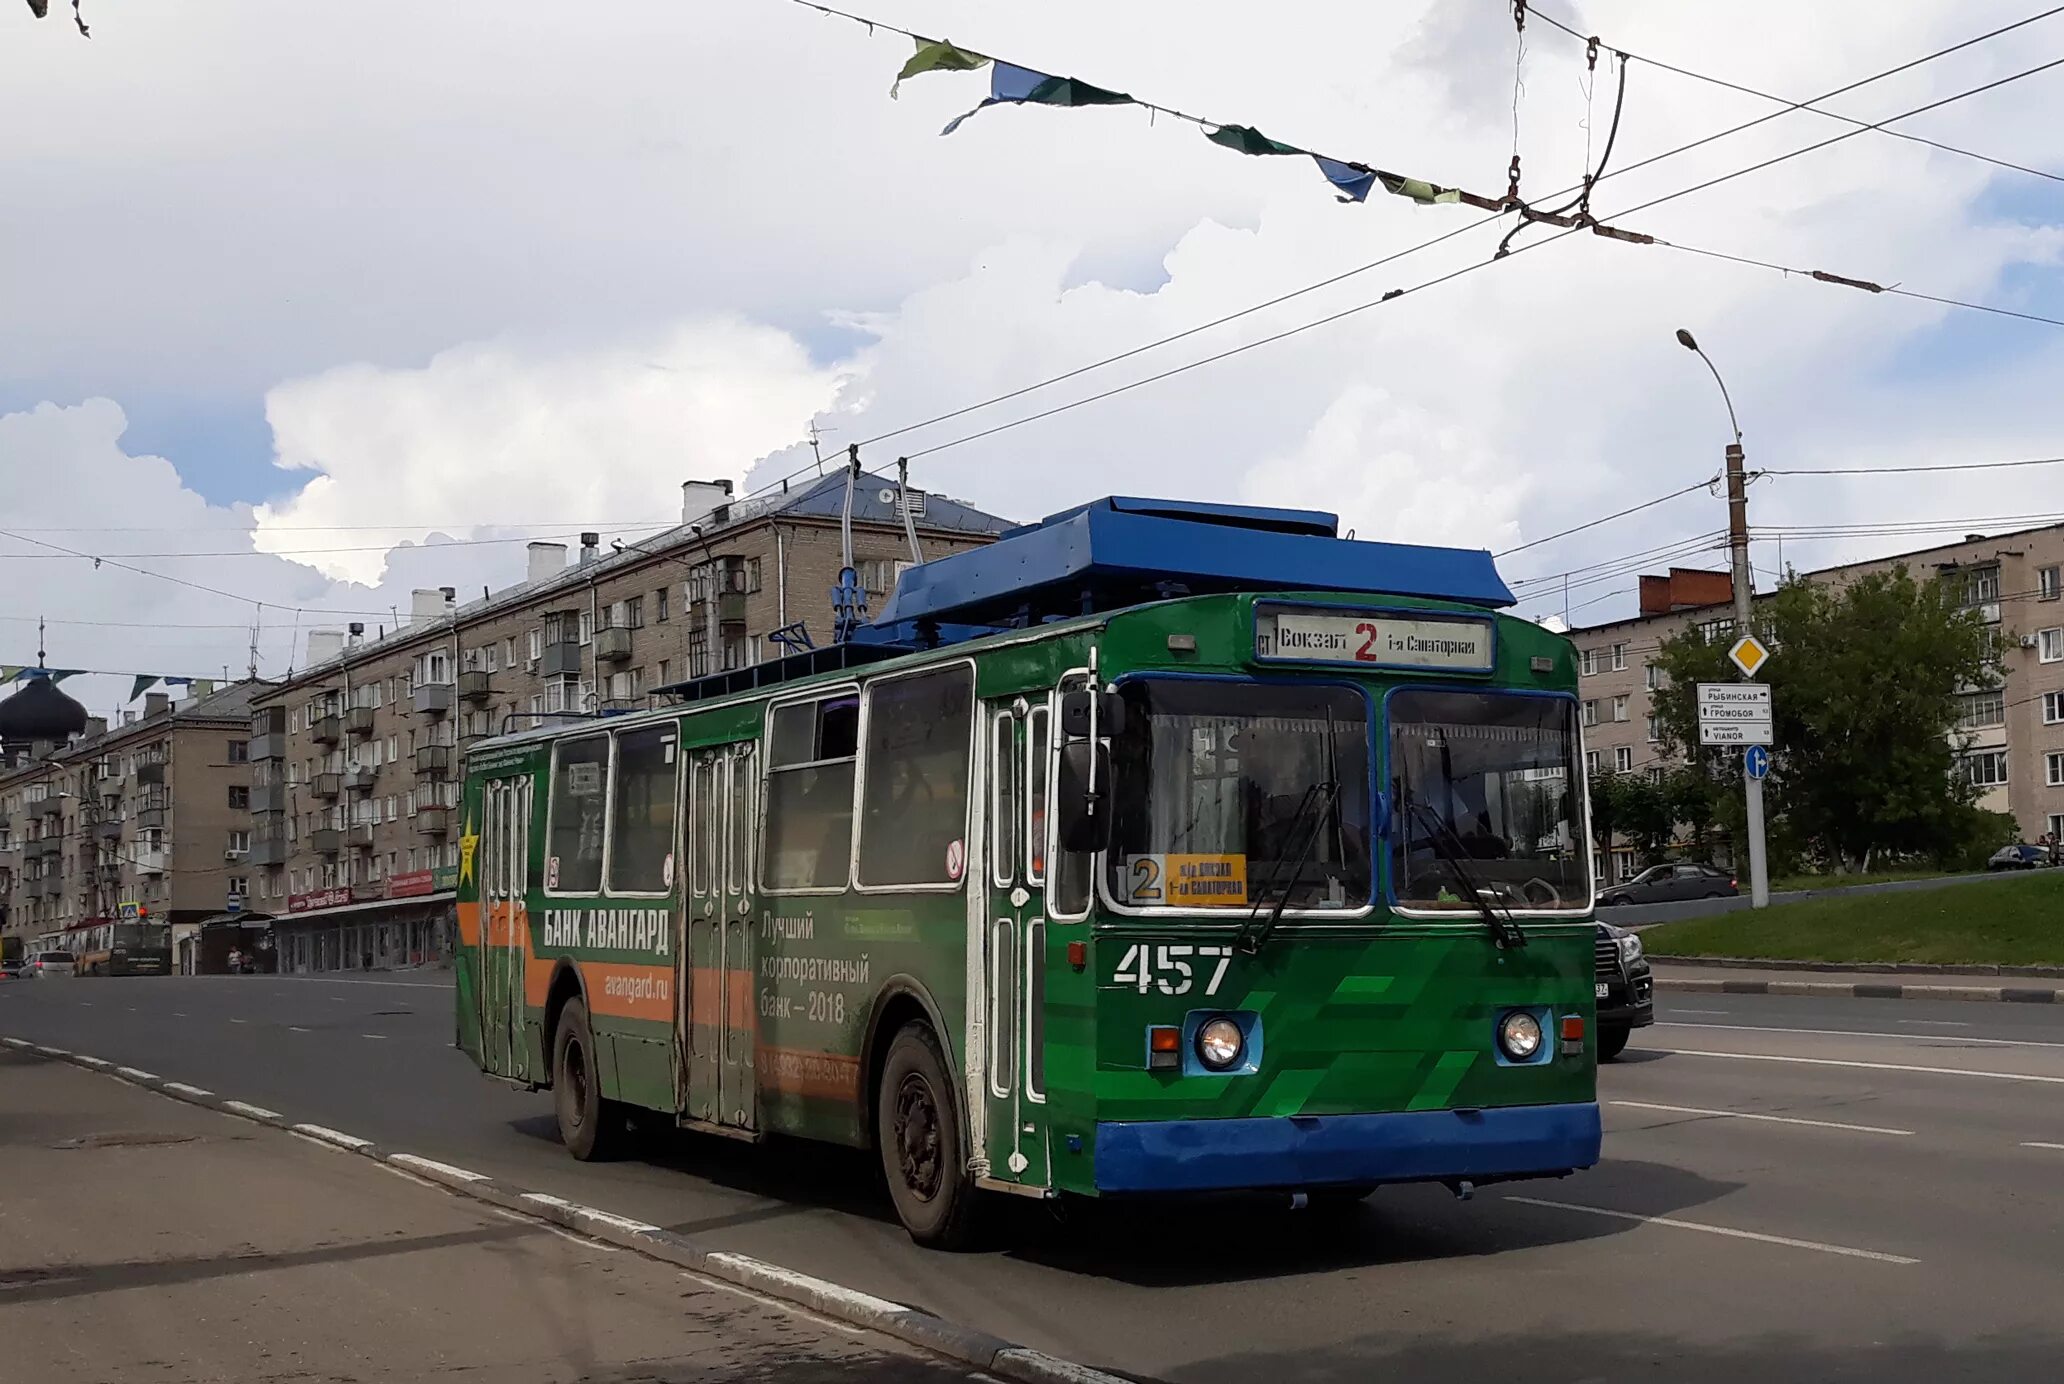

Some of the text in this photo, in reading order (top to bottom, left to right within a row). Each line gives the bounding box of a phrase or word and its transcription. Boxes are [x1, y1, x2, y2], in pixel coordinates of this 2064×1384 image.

[1280, 628, 1347, 649] Вокзал
[1355, 623, 1378, 661] 2
[1407, 635, 1475, 657] Санаторная
[1708, 693, 1758, 701] РЫБИНСКАЯ
[1710, 709, 1754, 717] ГРОМОБОЯ
[1713, 732, 1744, 740] VIANOR
[1132, 858, 1162, 899] 2
[544, 909, 669, 956] БАНК АВАНГАРД
[761, 910, 814, 945] Лучший
[761, 953, 869, 986] корпоративный
[1113, 944, 1233, 996] 457
[605, 972, 668, 1004] avangard.ru
[760, 987, 791, 1018] банк
[808, 991, 844, 1024] 2018
